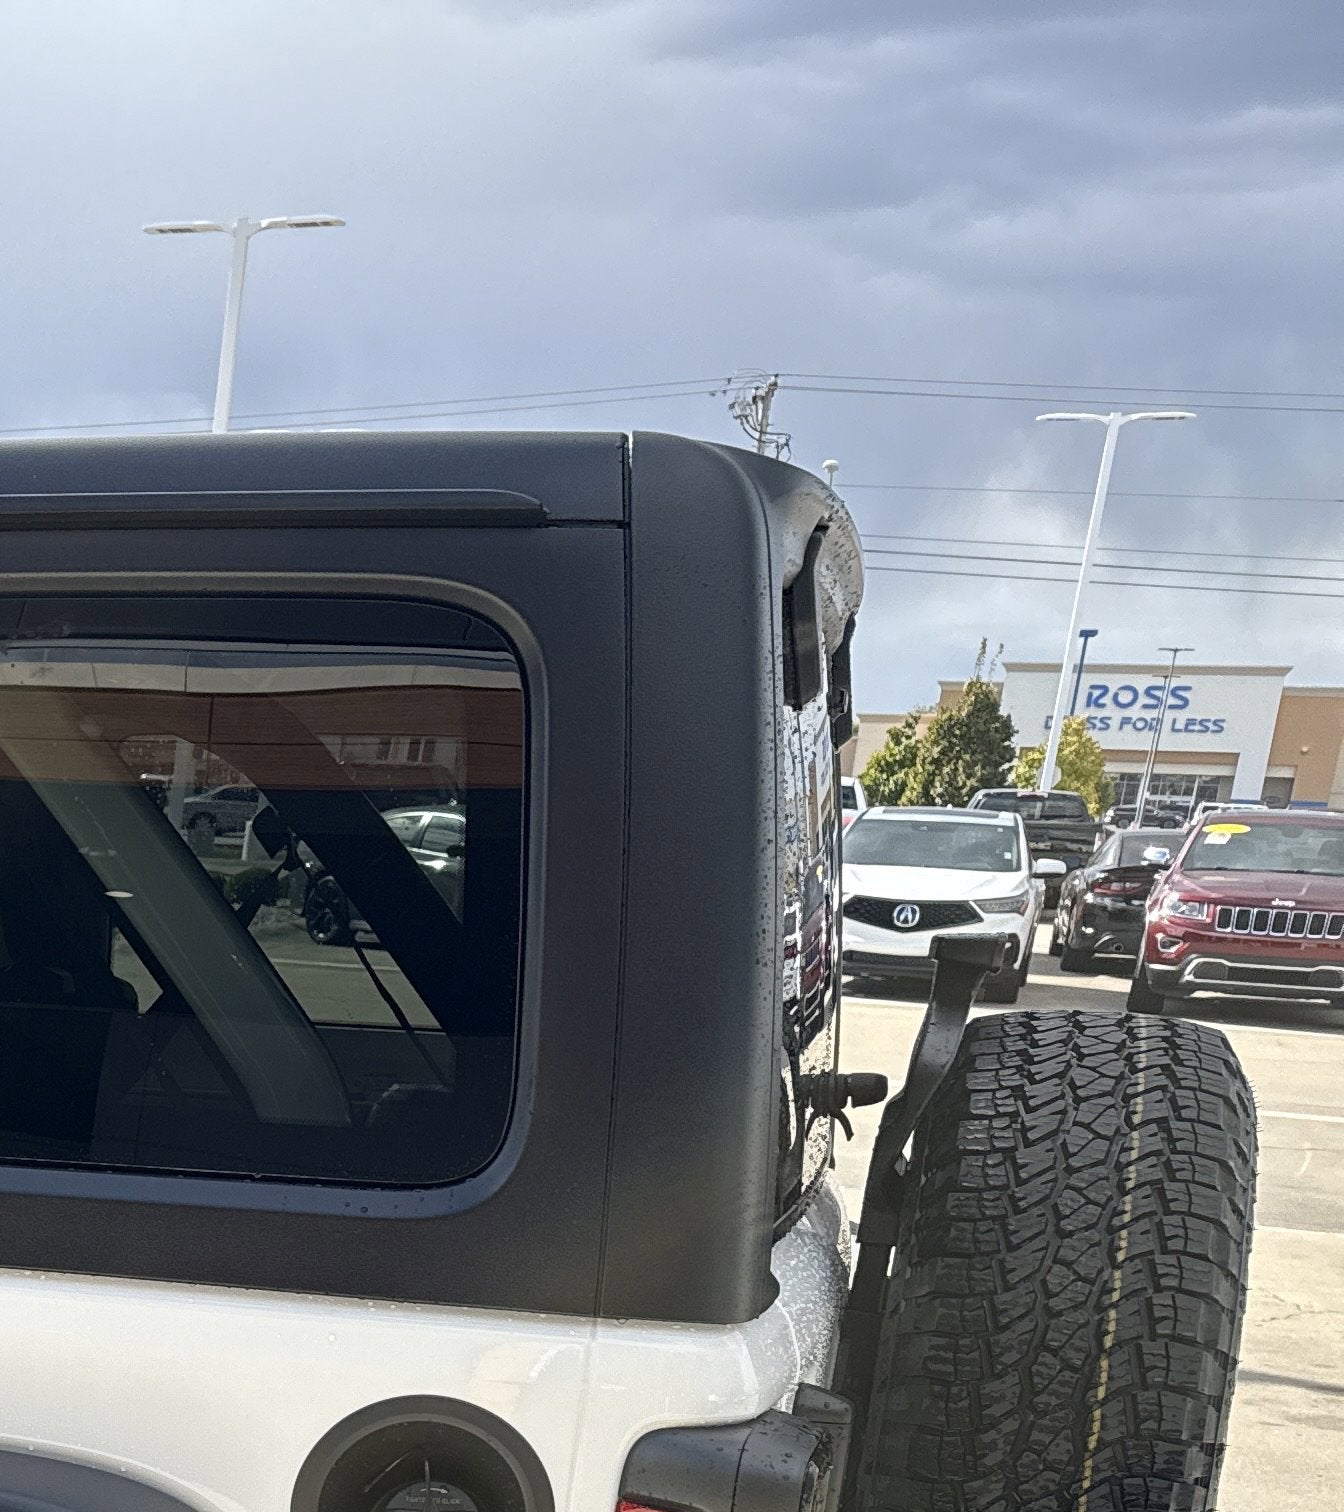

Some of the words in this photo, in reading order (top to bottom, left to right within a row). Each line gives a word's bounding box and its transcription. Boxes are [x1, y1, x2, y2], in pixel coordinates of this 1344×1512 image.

[1086, 684, 1193, 710] ROSS
[1044, 715, 1112, 732] DSS
[1170, 717, 1226, 733] LESS
